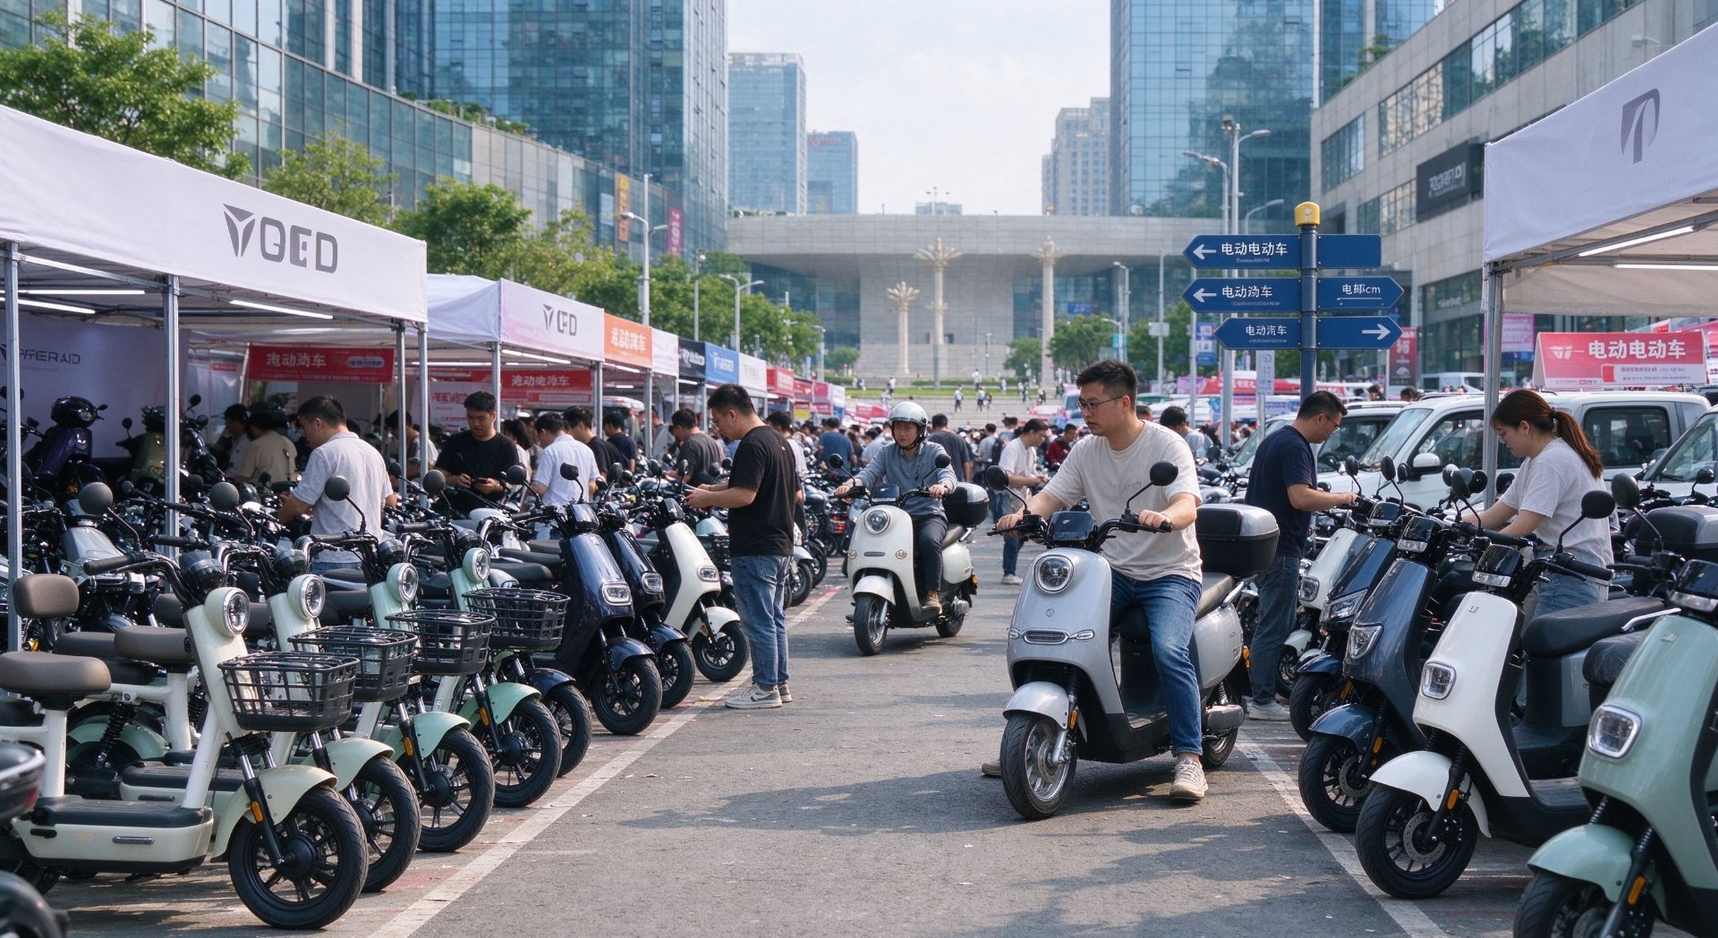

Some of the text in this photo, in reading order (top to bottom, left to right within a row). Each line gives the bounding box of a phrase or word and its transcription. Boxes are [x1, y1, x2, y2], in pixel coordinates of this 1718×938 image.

[1221, 241, 1288, 256] 电动电动车
[1588, 339, 1686, 359] 电动电动车
